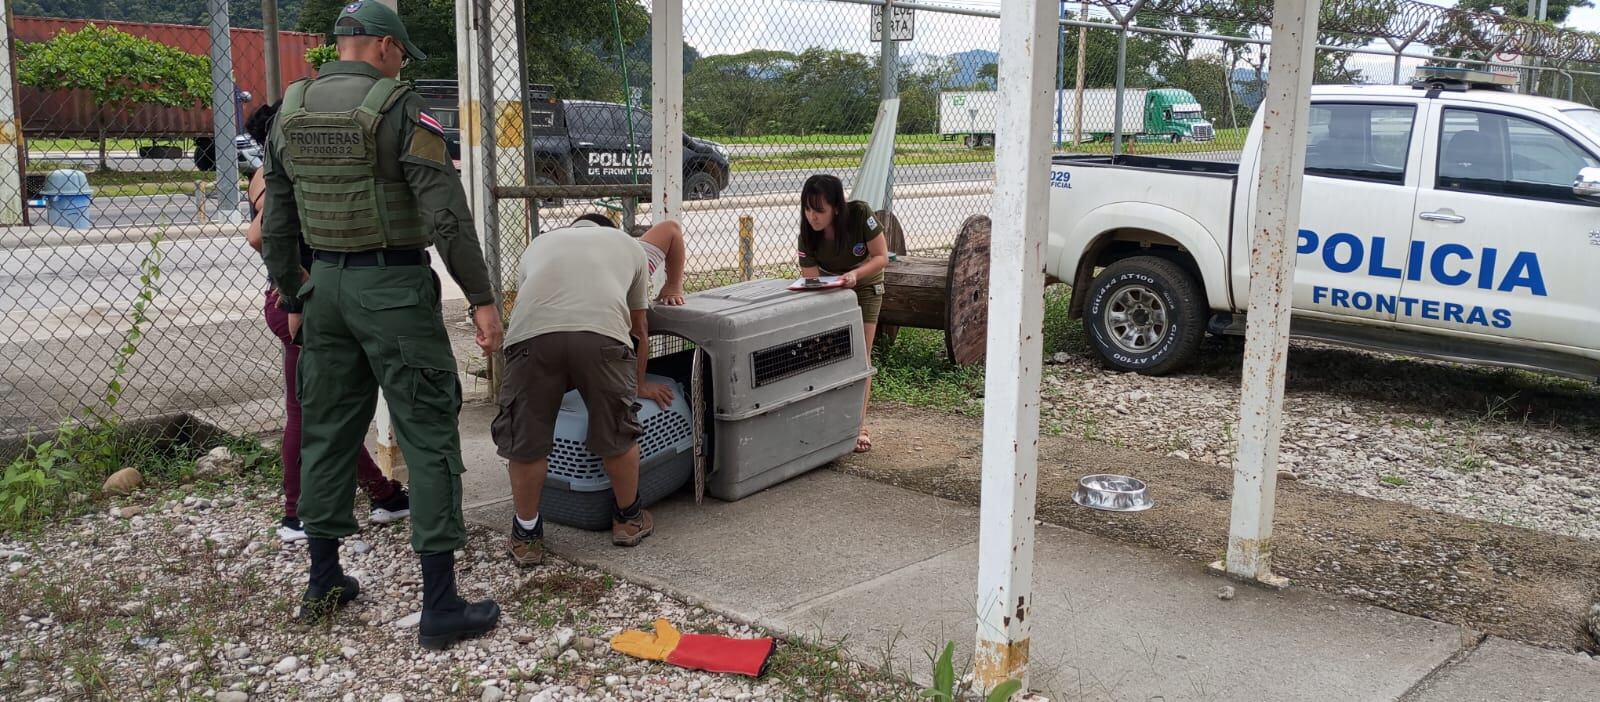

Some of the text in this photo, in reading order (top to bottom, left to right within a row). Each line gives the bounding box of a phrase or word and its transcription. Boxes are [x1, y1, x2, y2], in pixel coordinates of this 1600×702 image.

[876, 20, 908, 33] CRTA
[290, 132, 360, 145] FRONTERAS
[300, 146, 353, 154] PF000032
[588, 167, 653, 175] DE FRONTRAS
[1050, 181, 1072, 189] FICIAL
[1296, 229, 1548, 297] POLICIA
[1120, 272, 1155, 285] AT100
[1313, 285, 1513, 329] FRONTERAS
